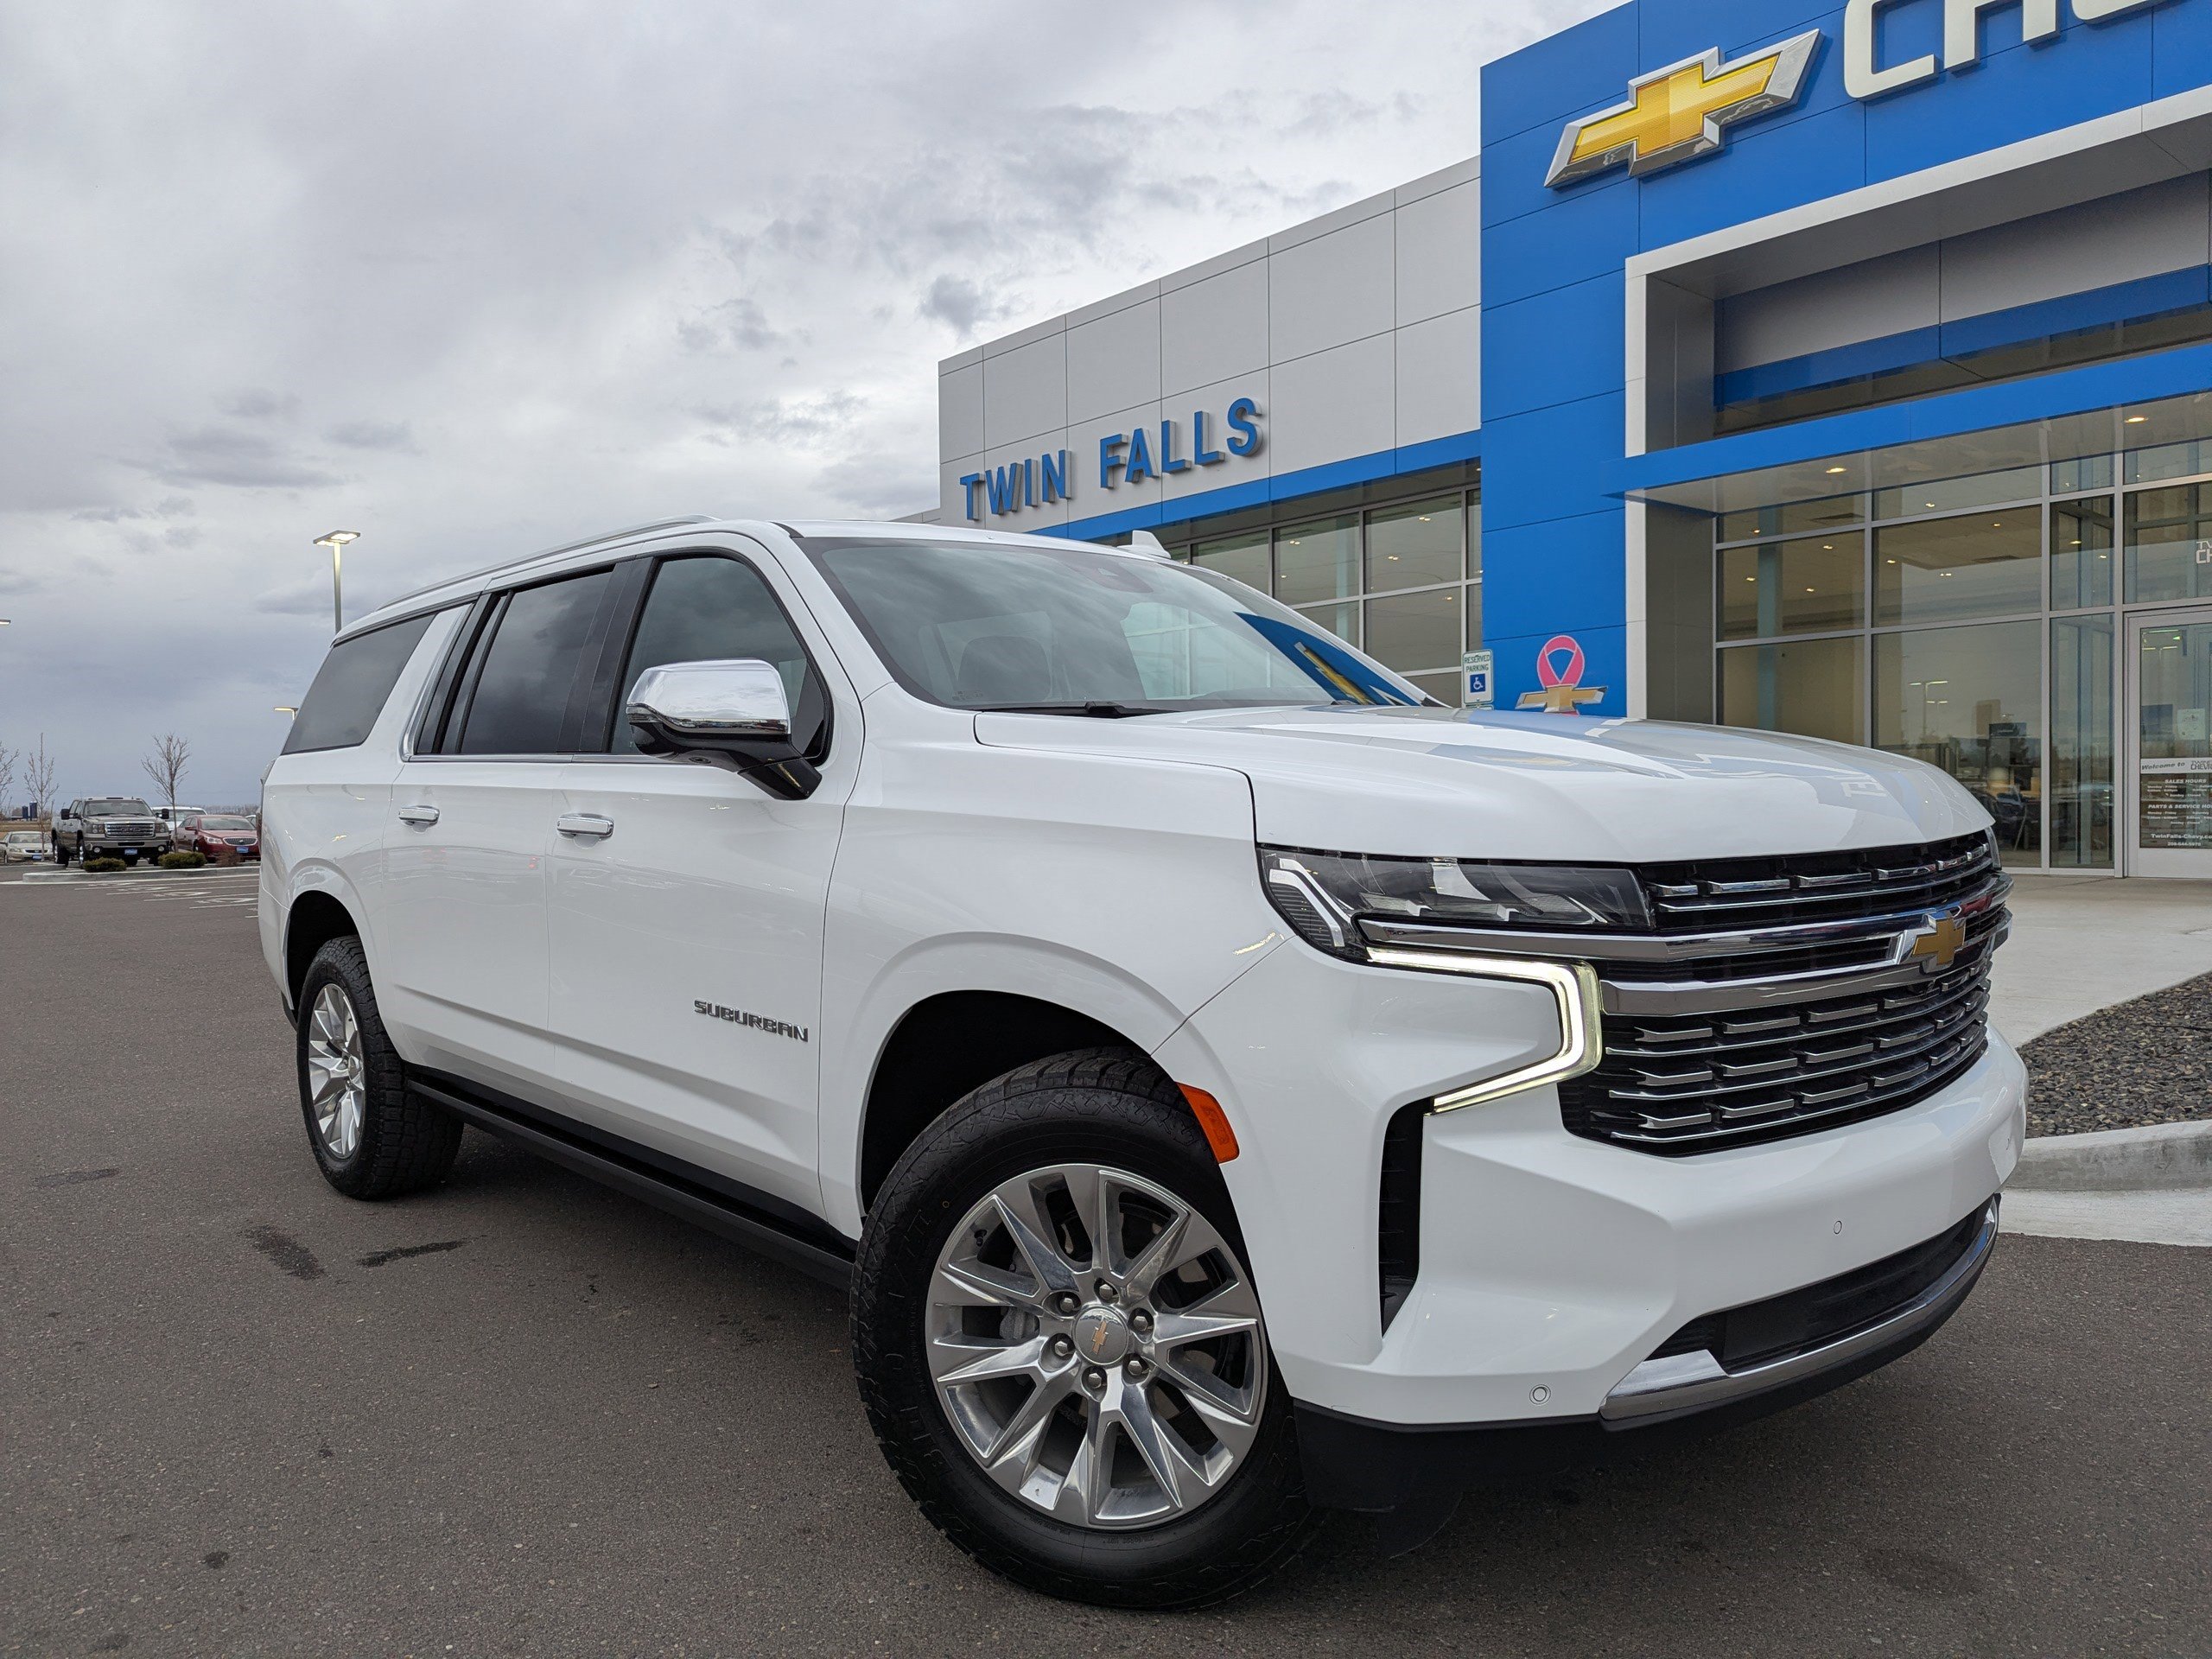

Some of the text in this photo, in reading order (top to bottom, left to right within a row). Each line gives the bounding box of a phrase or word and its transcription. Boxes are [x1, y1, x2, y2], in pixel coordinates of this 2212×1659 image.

[960, 397, 1262, 520] TWIN FALLS
[1465, 655, 1491, 664] RESERVED
[1466, 664, 1489, 672] PARKING
[694, 999, 809, 1043] SUBURBAN
